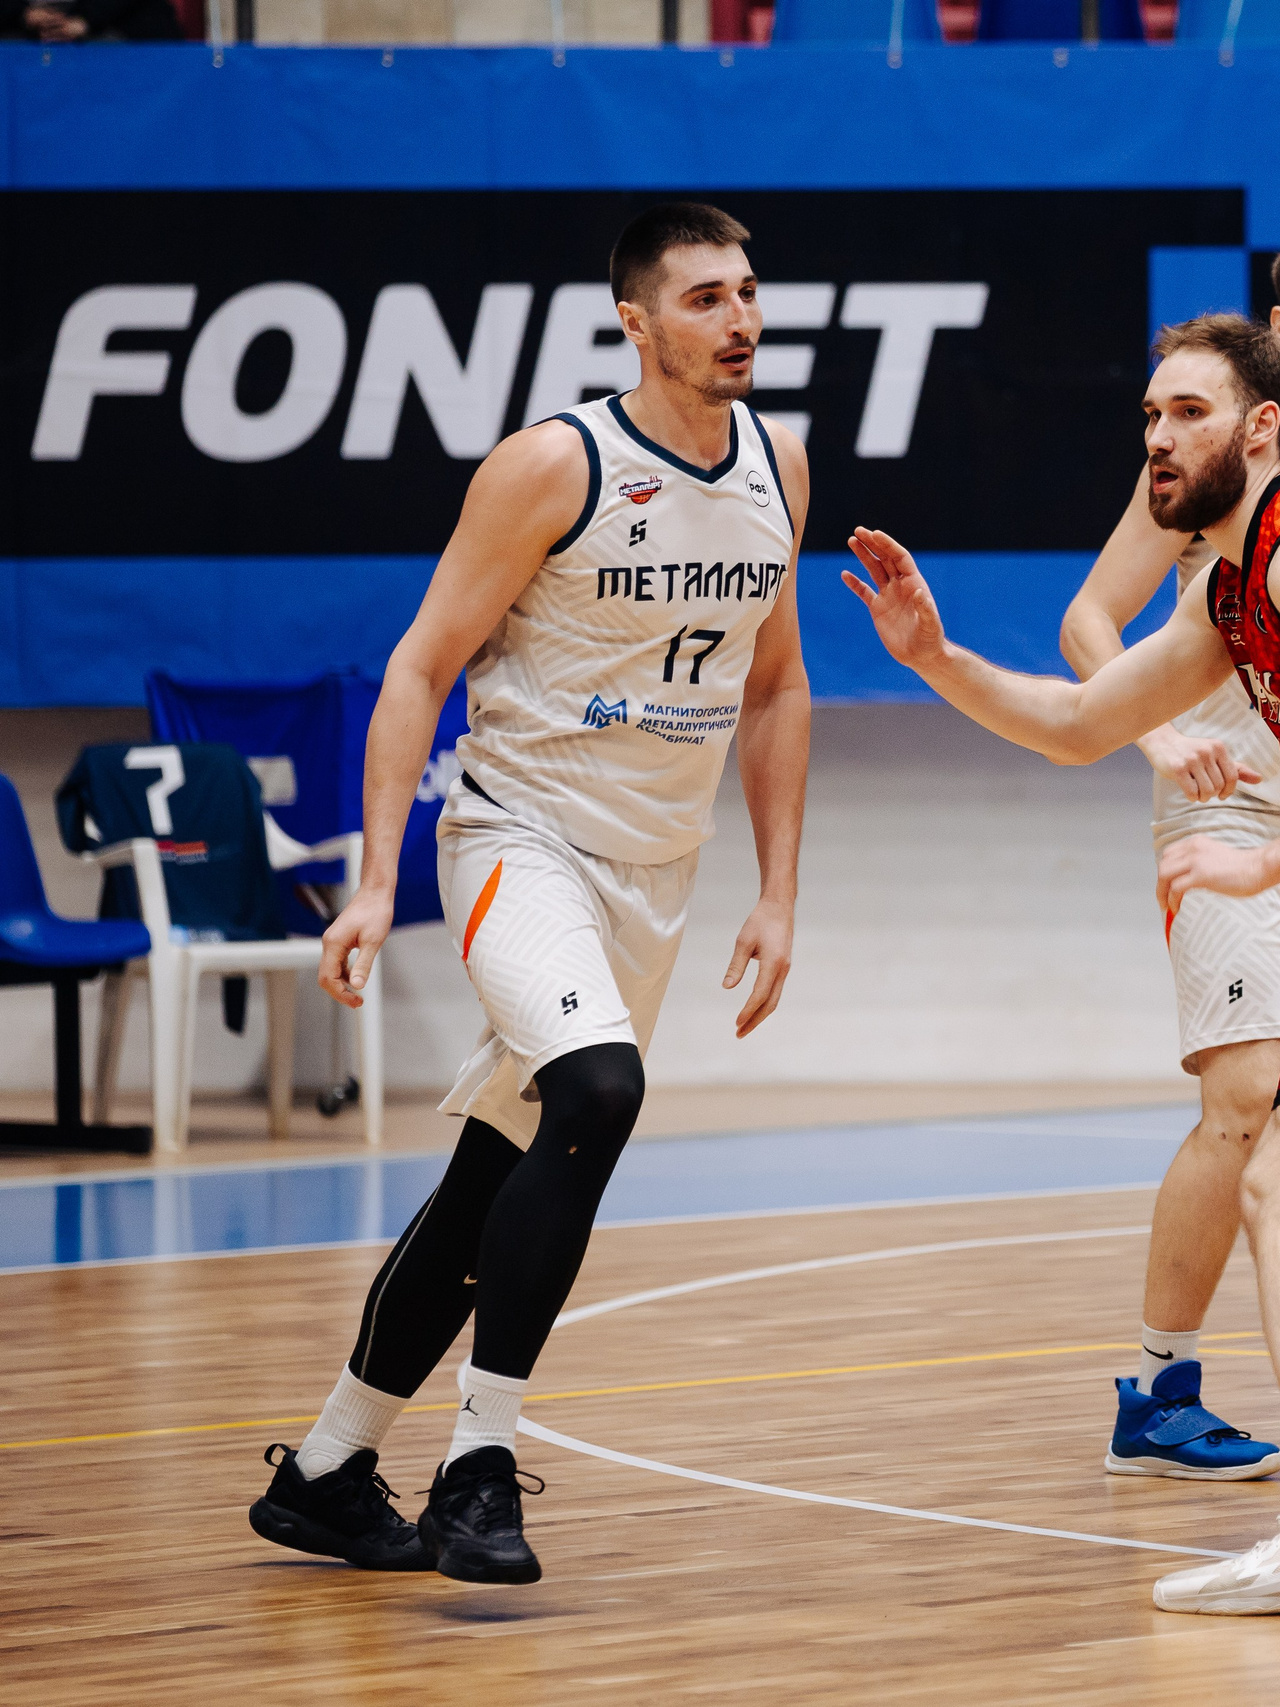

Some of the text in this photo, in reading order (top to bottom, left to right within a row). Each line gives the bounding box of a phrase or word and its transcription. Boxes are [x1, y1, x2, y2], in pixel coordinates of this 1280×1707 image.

[619, 481, 662, 497] МЕТАЛЛУРГ
[749, 483, 767, 495] РФБ
[597, 561, 787, 604] МЕТАЛЛУРГ
[662, 623, 726, 685] 17
[124, 745, 186, 836] 7
